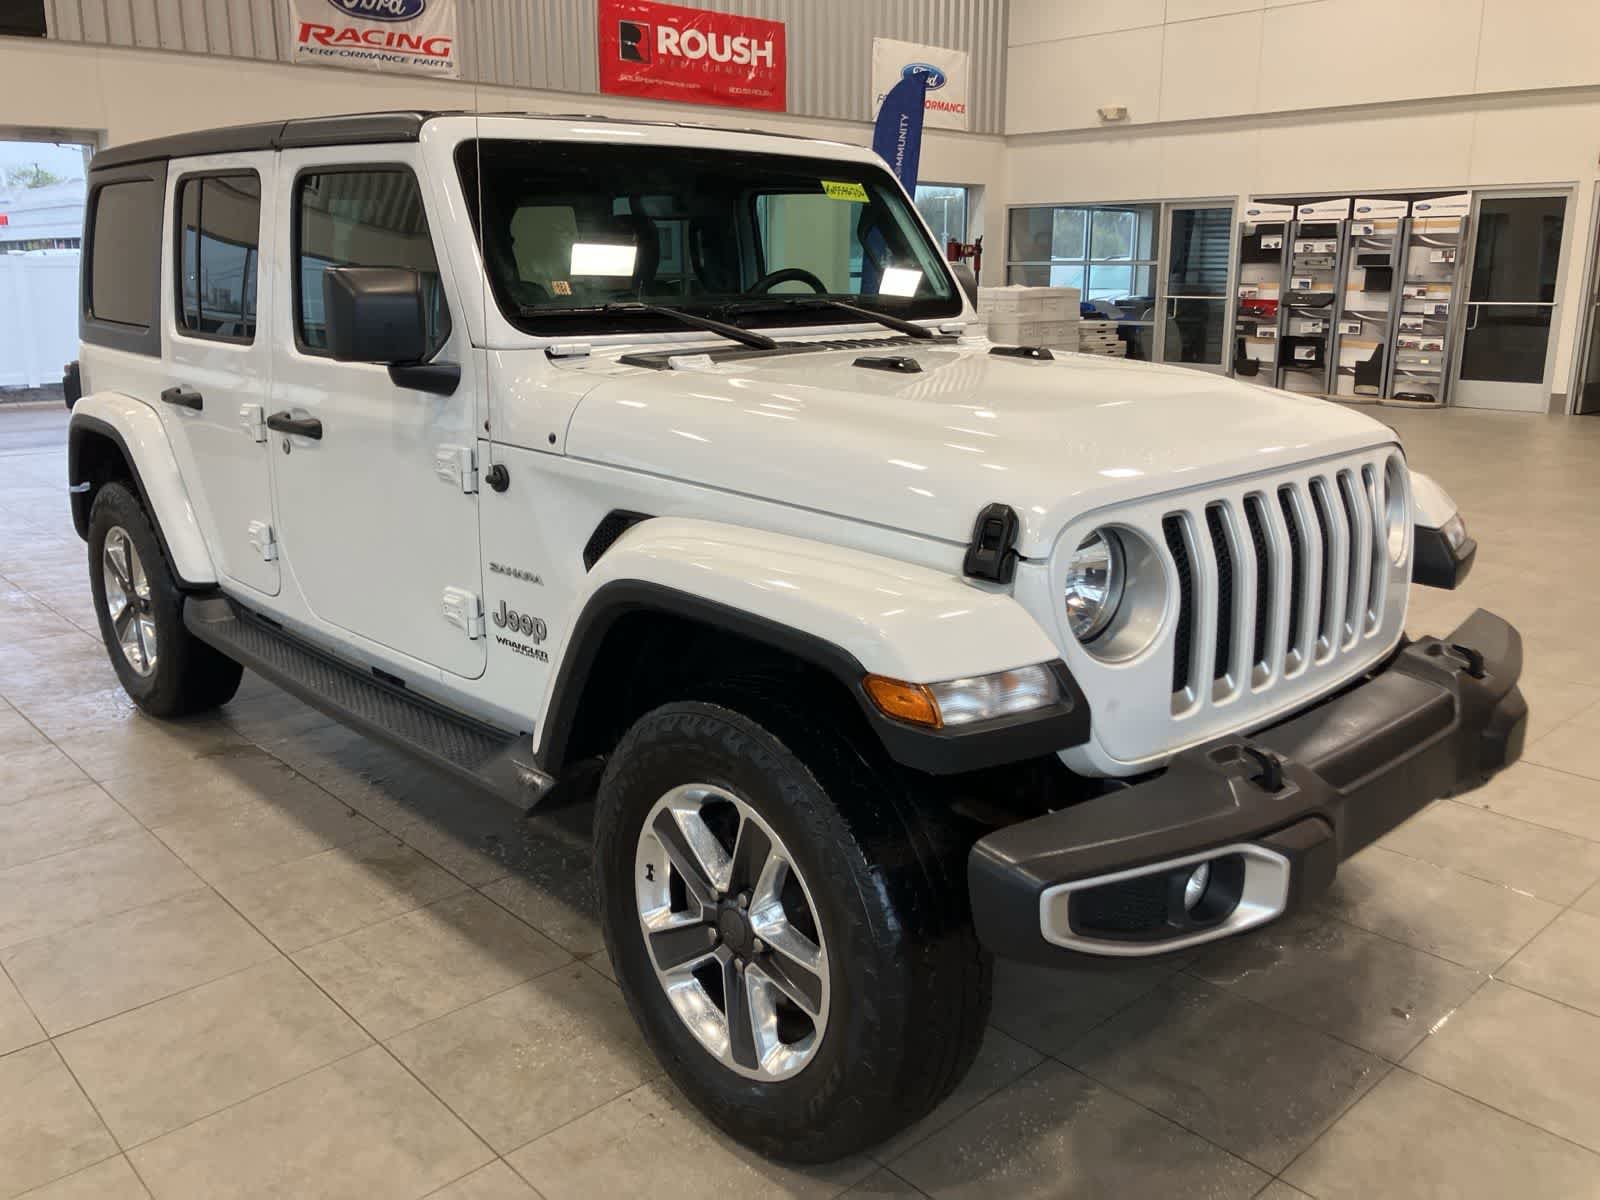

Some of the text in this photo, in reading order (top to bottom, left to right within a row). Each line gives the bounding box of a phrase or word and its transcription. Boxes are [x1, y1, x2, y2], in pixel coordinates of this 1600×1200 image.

[298, 22, 453, 57] RACING
[657, 25, 774, 68] ROUSH
[298, 46, 454, 68] PERFORMANCE PARTS
[925, 99, 966, 114] ORMANCE
[492, 599, 547, 645] Jeep
[495, 634, 549, 660] WRANGLER
